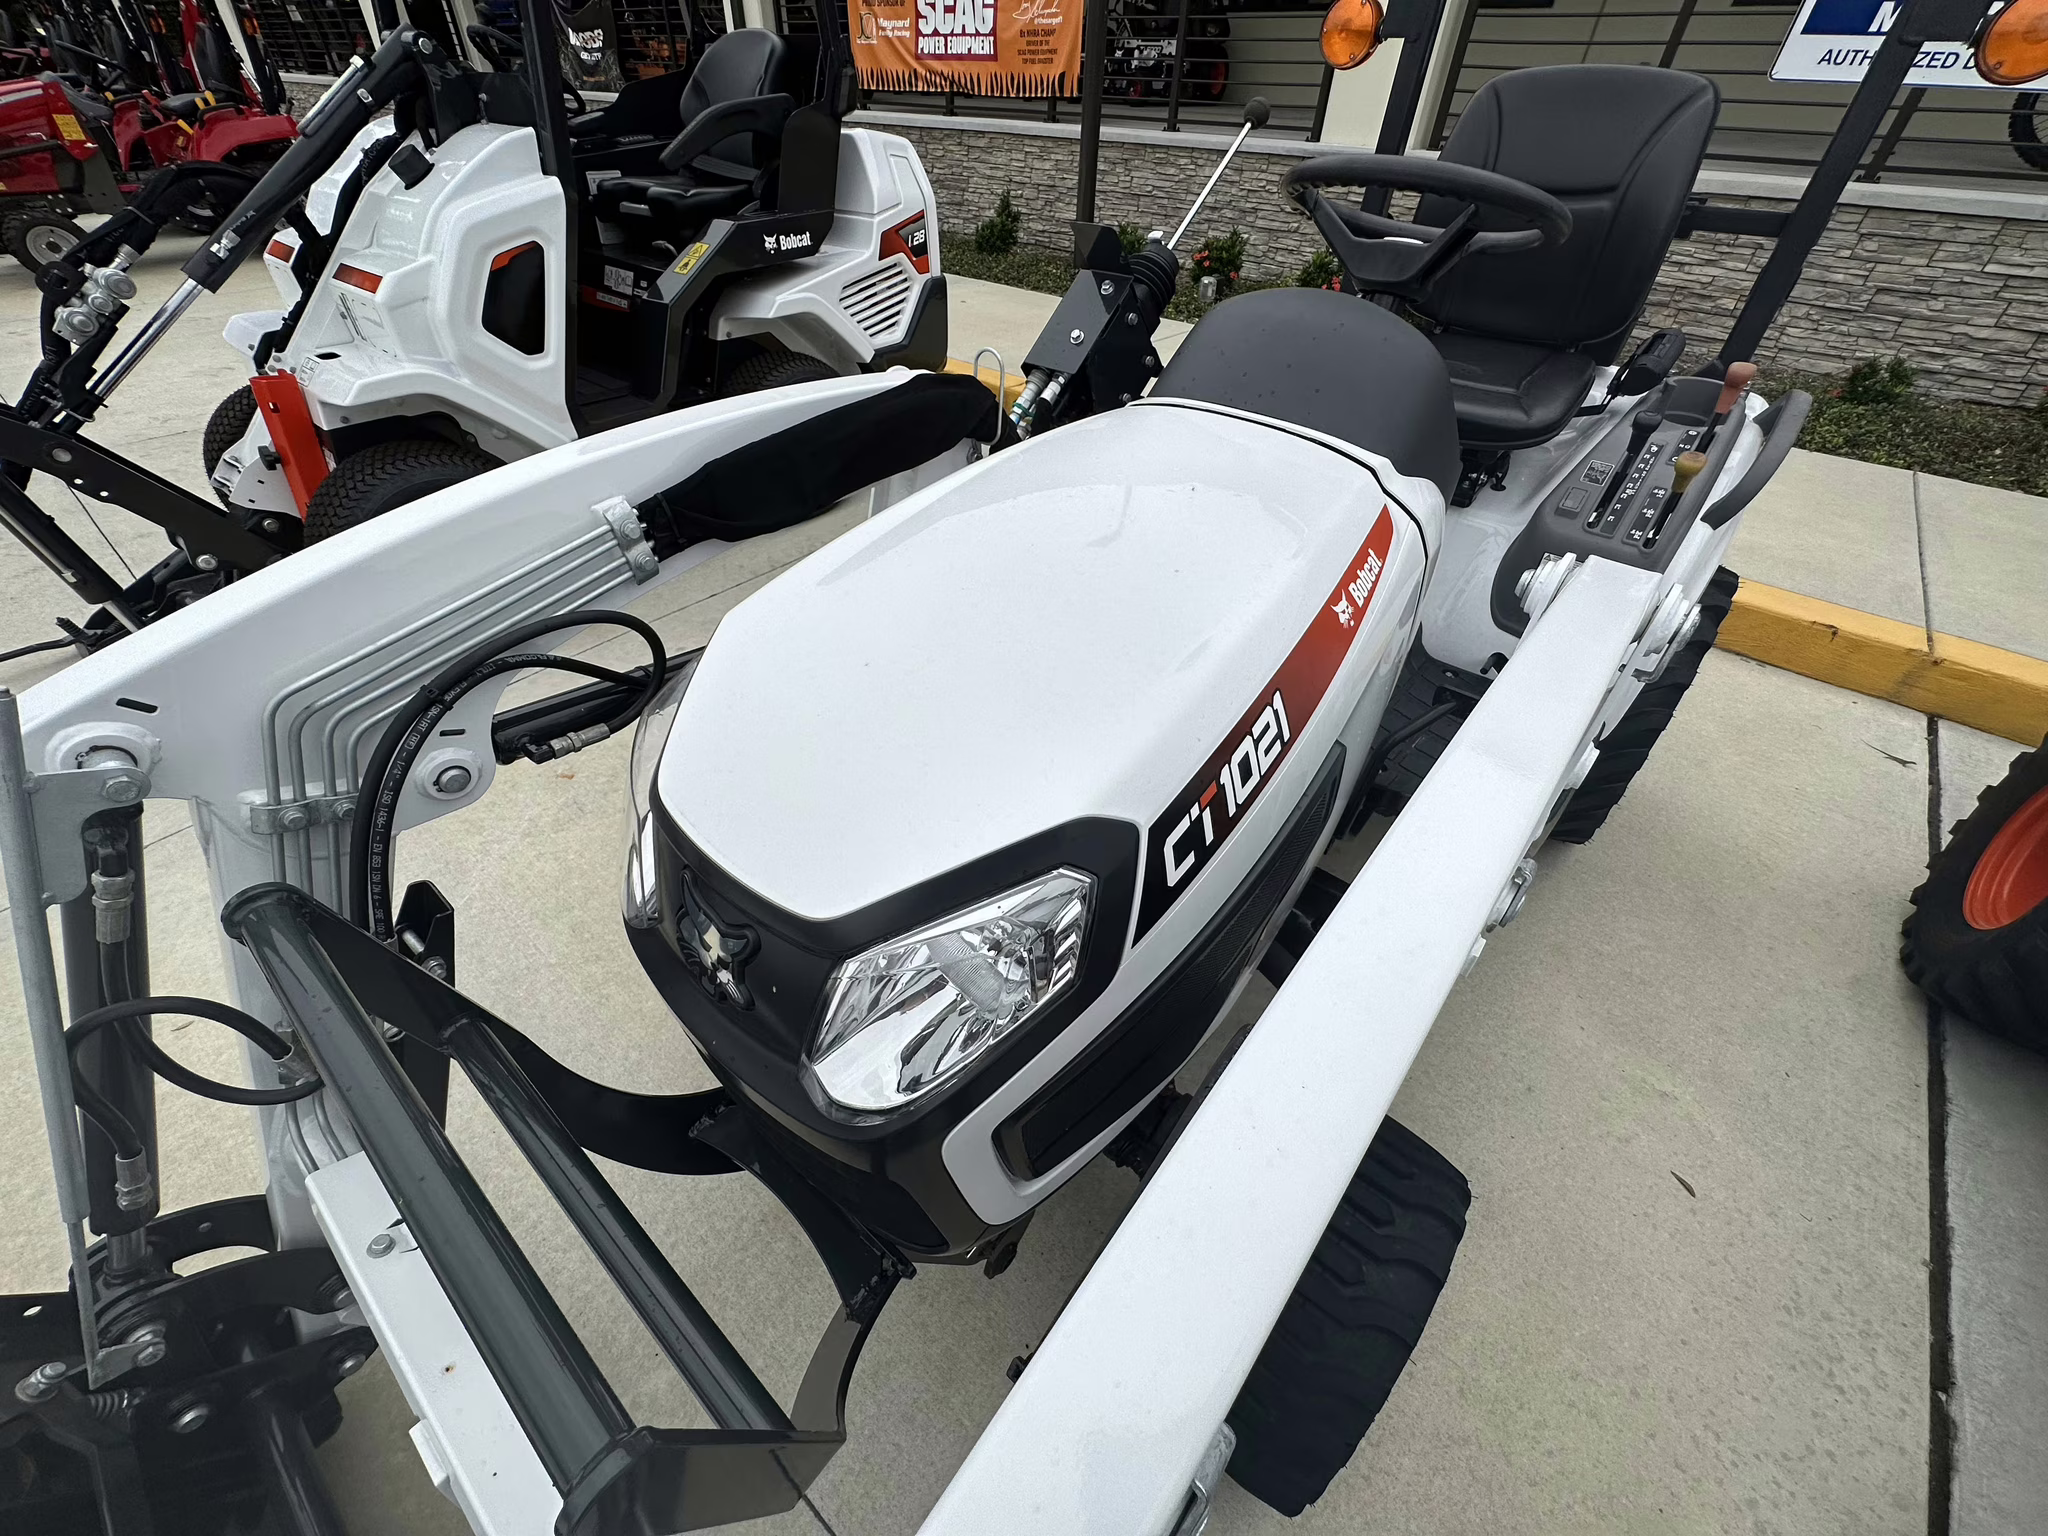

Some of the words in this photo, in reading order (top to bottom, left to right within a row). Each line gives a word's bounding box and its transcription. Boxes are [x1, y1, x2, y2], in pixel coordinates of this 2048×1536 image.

[916, 0, 994, 34] SCAG
[918, 36, 945, 54] POWER
[947, 36, 994, 54] EQUIPMENT
[779, 231, 812, 250] Bobcat
[1348, 548, 1382, 608] Bobcat
[381, 789, 394, 804] ISO
[1163, 690, 1291, 887] CT1021
[375, 807, 389, 832] 1436-1
[372, 843, 383, 853] EN
[371, 871, 382, 882] 1SN
